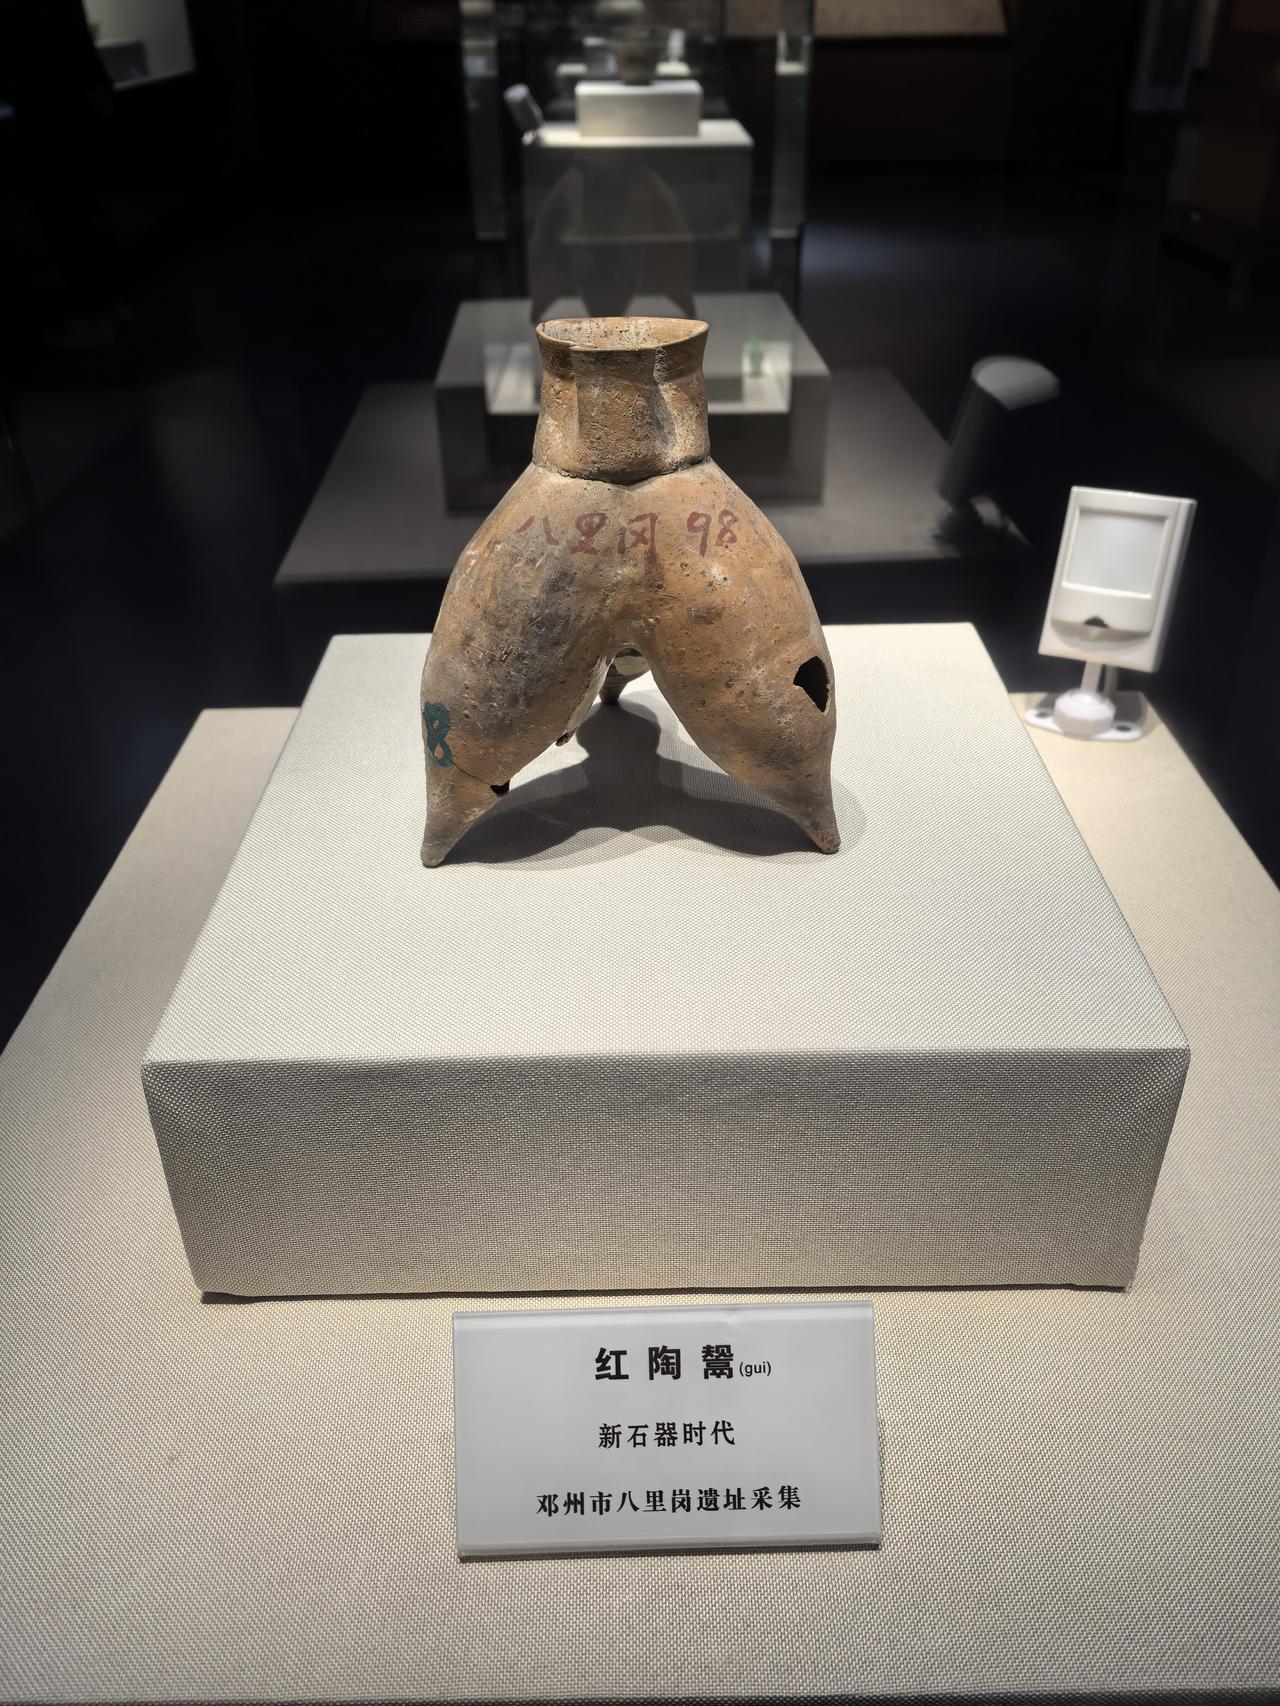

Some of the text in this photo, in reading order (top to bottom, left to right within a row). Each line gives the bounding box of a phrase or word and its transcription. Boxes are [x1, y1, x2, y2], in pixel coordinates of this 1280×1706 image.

[686, 509, 739, 558] 98
[739, 1360, 772, 1378] (gui)
[598, 1419, 736, 1449] 新石器时代
[536, 1484, 801, 1518] 邓州市八里岗遗址采集
